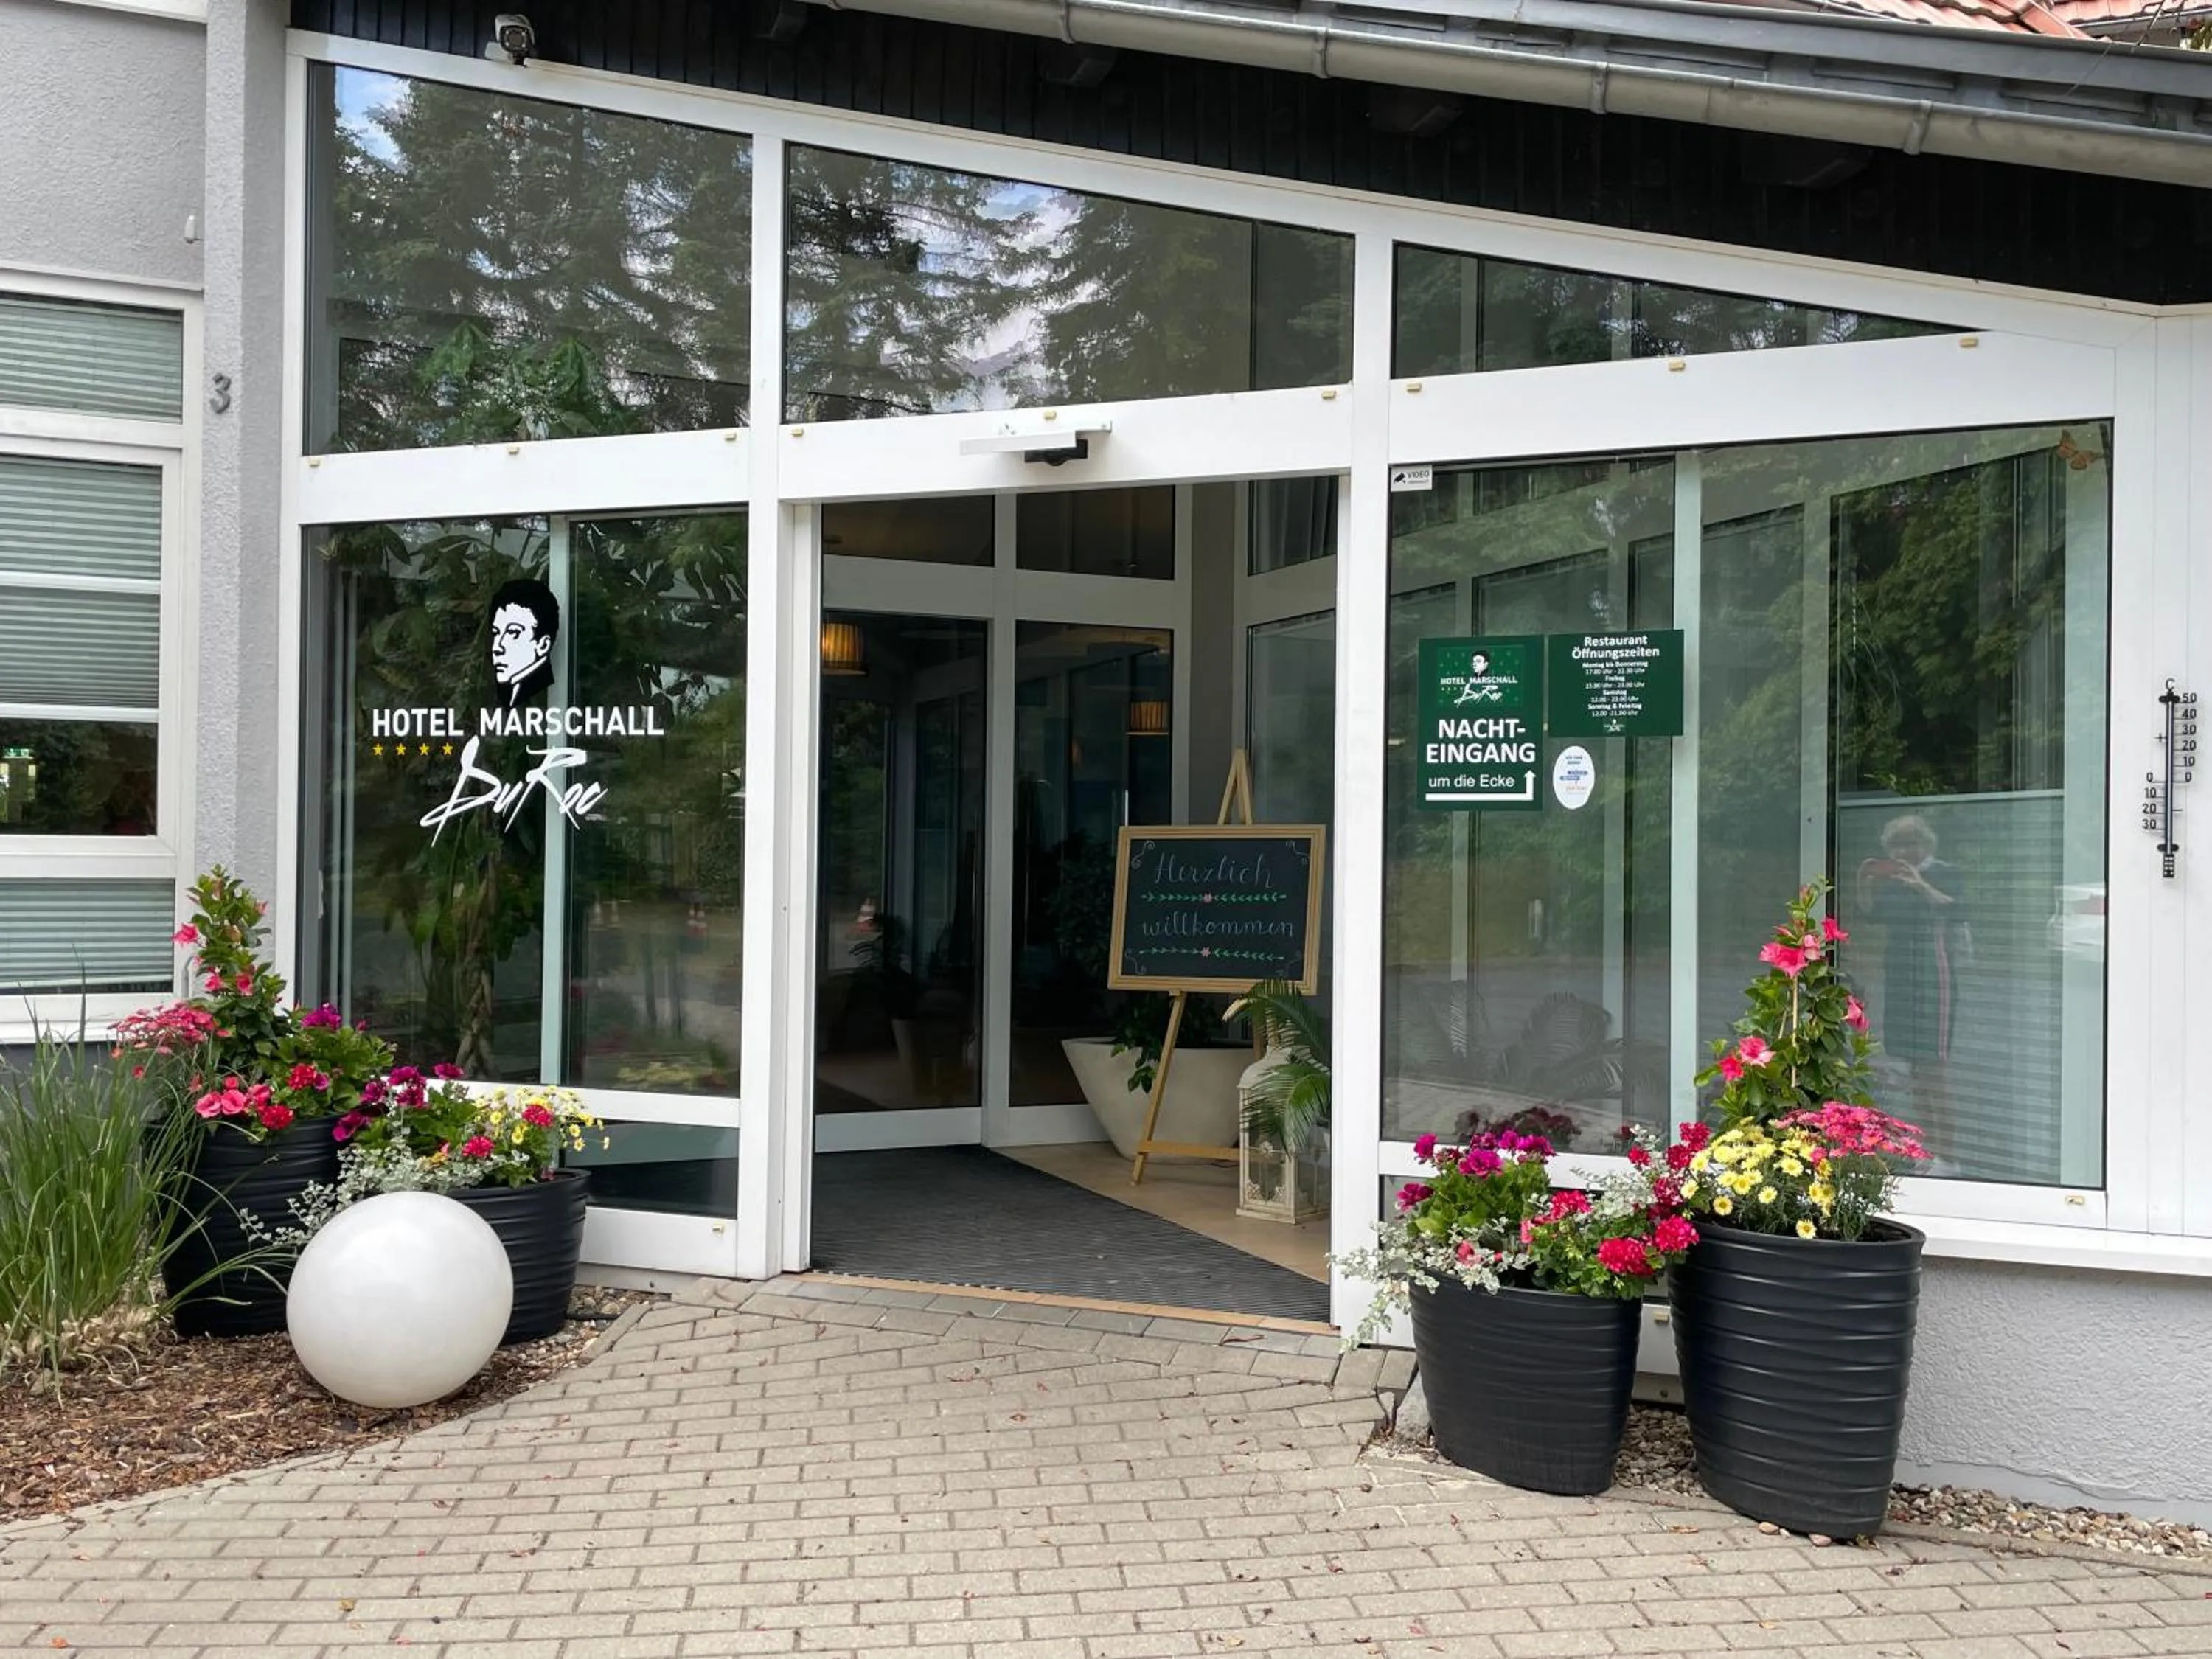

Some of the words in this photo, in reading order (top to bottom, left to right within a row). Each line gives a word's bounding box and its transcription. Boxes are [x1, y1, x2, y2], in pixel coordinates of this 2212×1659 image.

[209, 373, 232, 414] 3
[1407, 470, 1430, 479] VIDEO
[1585, 635, 1648, 647] Restaurant
[1571, 646, 1660, 659] Öffnungszeiten
[1440, 677, 1466, 685] HOTEL
[1470, 675, 1518, 684] MARSCHALL
[2182, 692, 2197, 703] 50
[2182, 709, 2197, 719] 40
[372, 707, 464, 737] HOTEL
[480, 706, 664, 736] MARSCHALL
[1439, 719, 1526, 739] NACHT-
[2182, 724, 2197, 735] 30
[2182, 740, 2197, 751] 20
[1426, 742, 1536, 764] EINGANG
[2183, 756, 2195, 767] 10
[1429, 779, 1450, 787] um
[1454, 774, 1475, 787] die
[1480, 773, 1515, 787] Ecke
[2146, 773, 2153, 782] 0
[2185, 773, 2192, 782] 0
[2144, 787, 2157, 798] 10
[2142, 804, 2157, 814] 20
[2142, 819, 2157, 830] 30
[1155, 851, 1275, 888] Herzlich
[1143, 911, 1293, 936] willkommen
